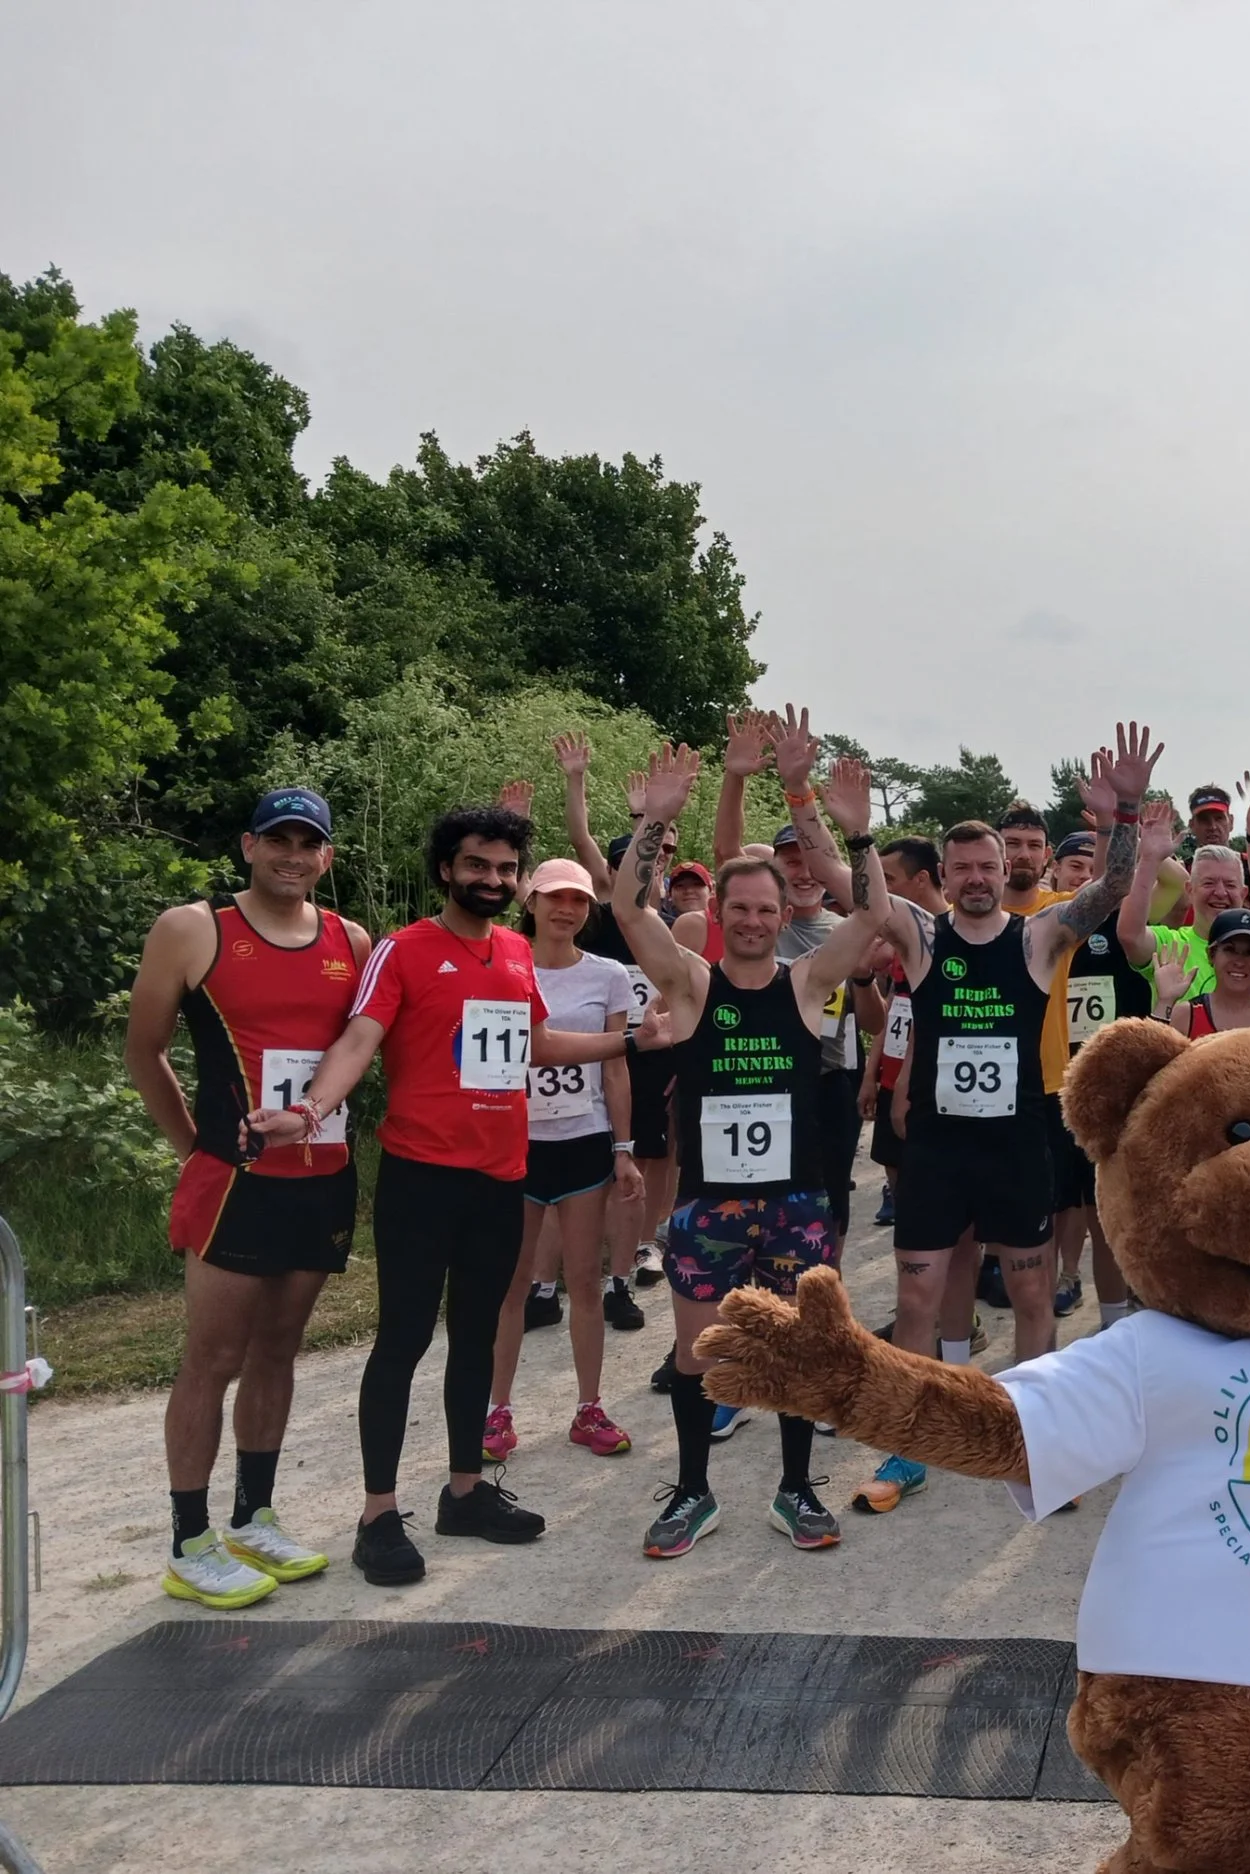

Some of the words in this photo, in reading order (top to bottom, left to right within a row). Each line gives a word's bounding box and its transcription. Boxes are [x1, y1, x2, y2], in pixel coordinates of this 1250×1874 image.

[954, 987, 1001, 1001] REBEL
[942, 1004, 1015, 1018] RUNNERS
[1067, 995, 1105, 1023] 76
[961, 1022, 995, 1030] MEDWAY
[472, 1027, 529, 1063] 117
[724, 1037, 782, 1051] REBEL
[712, 1056, 793, 1072] RUNNERS
[735, 1076, 774, 1085] MEDWAY
[954, 1061, 1001, 1093] 93
[723, 1121, 771, 1156] 19
